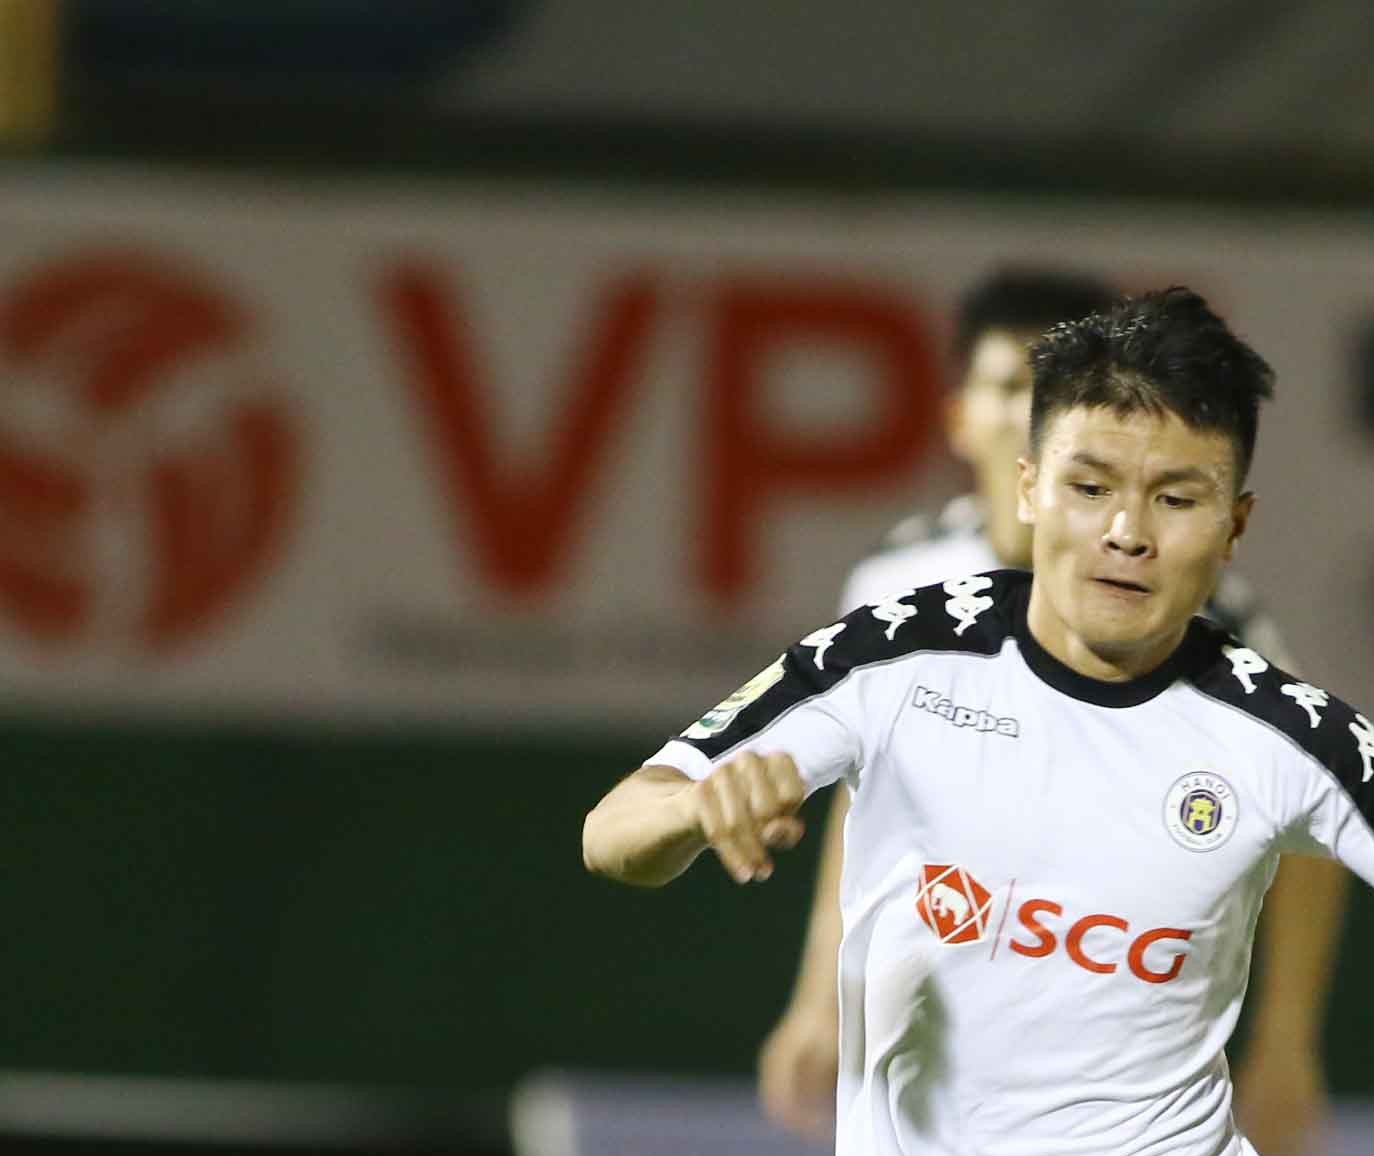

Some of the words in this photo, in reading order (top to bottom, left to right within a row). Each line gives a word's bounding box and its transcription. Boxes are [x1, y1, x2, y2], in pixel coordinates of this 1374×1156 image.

[373, 258, 985, 608] VP
[911, 685, 1019, 738] Kappa
[1009, 898, 1192, 984] SCG
